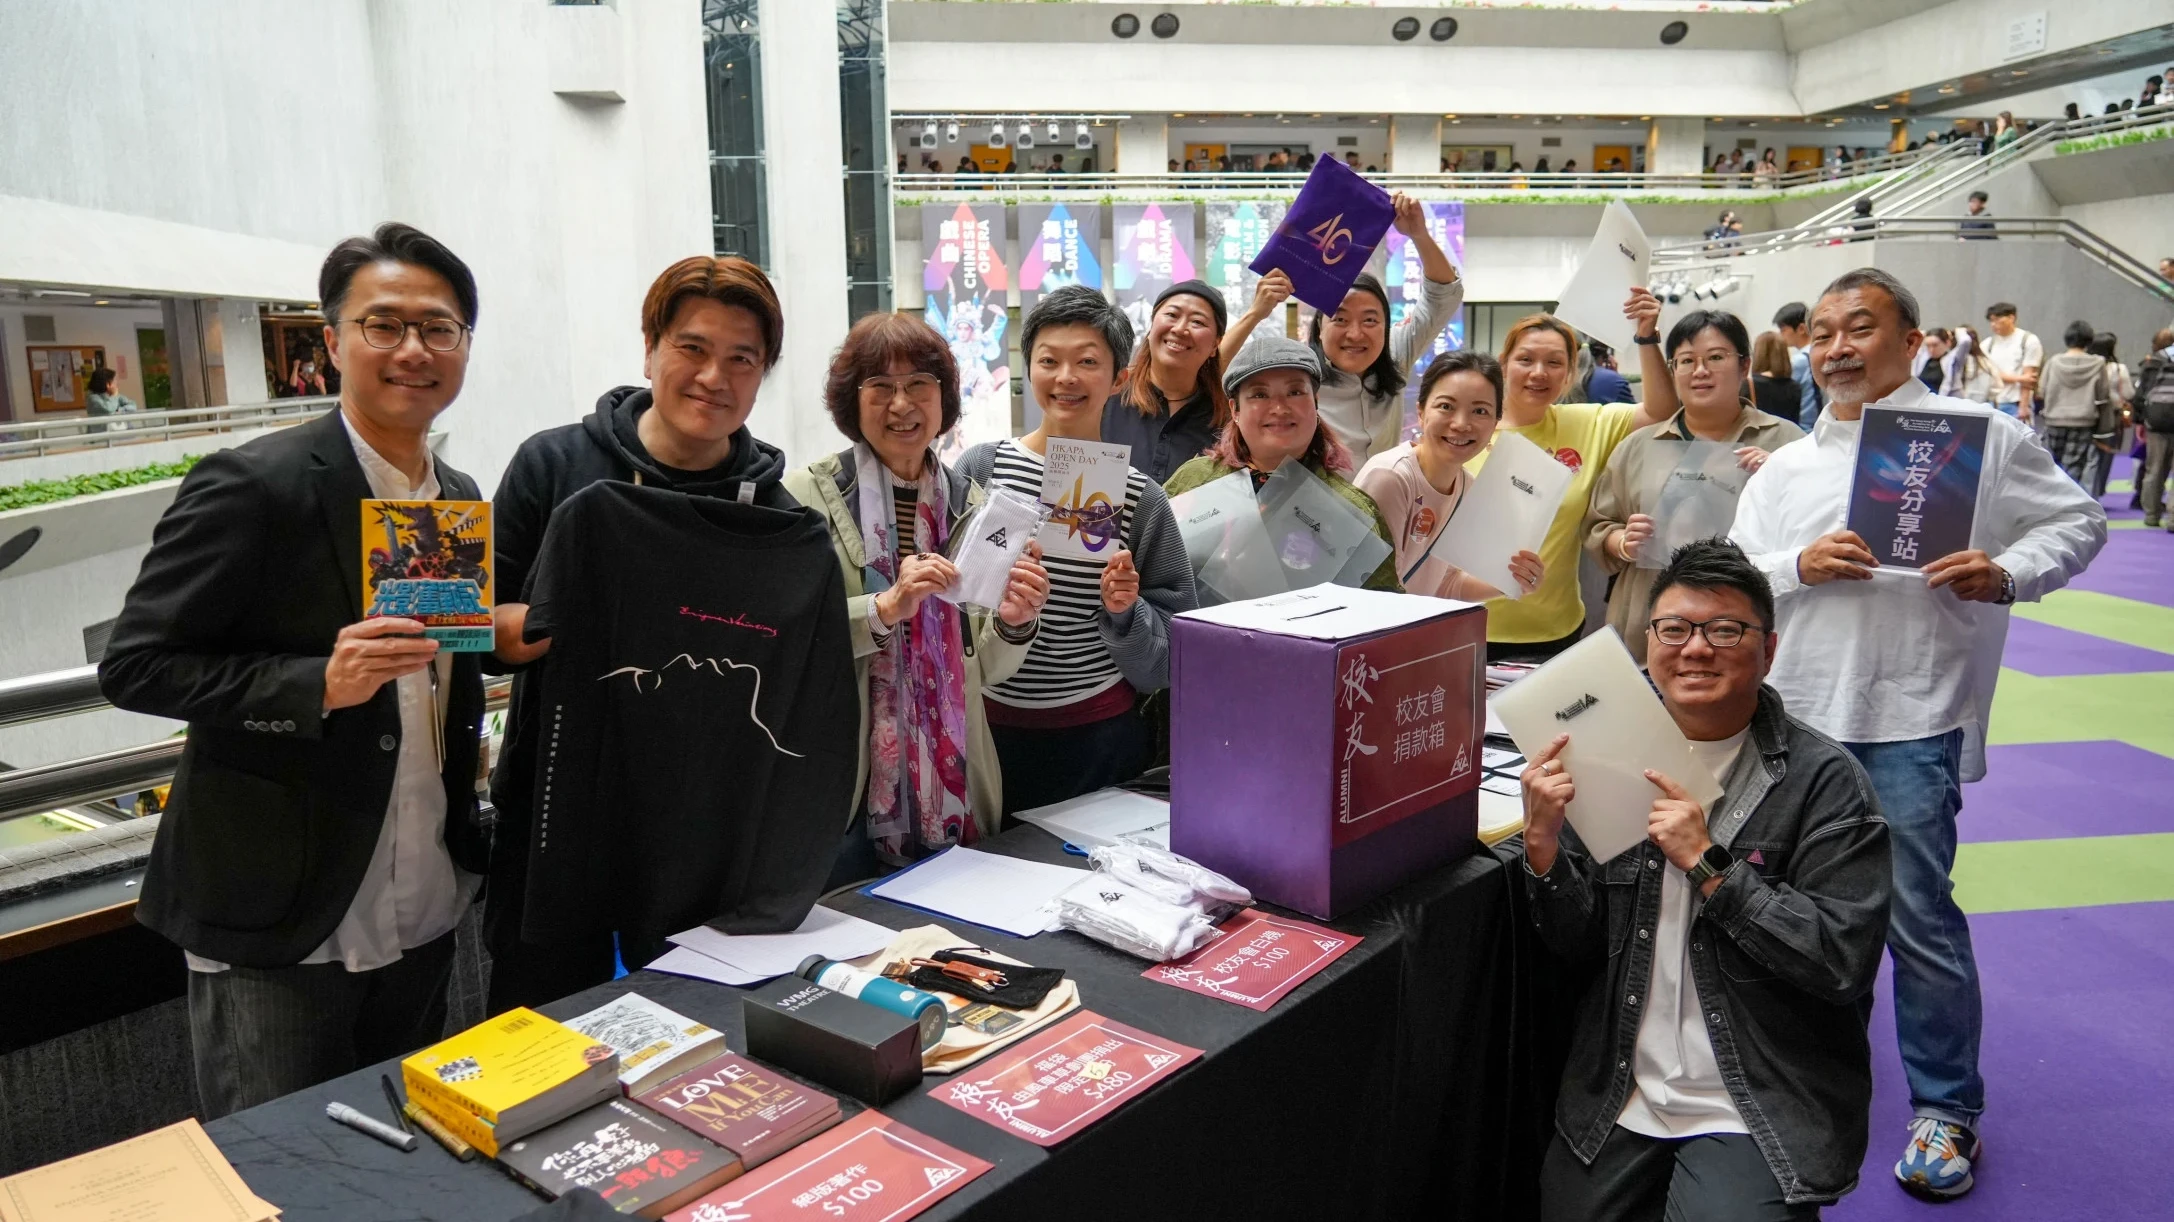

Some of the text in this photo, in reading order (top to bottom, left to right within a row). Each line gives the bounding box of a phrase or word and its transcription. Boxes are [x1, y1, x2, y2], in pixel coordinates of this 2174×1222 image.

[963, 220, 977, 289] CHINESE
[978, 219, 991, 273] OPERA
[1064, 219, 1078, 271] DANCE
[1159, 219, 1172, 273] DRAMA
[1049, 462, 1070, 470] 2025
[1050, 453, 1076, 463] OPEN
[1079, 455, 1099, 465] DAY
[1052, 444, 1085, 455] HKAPA
[1891, 440, 1935, 561] 校友分享站
[1396, 684, 1446, 727] 校友會
[1393, 720, 1446, 765] 捐款箱
[1339, 768, 1348, 824] ALUMNI
[1252, 947, 1291, 969] $100
[776, 985, 820, 1007] WMG
[787, 990, 832, 1012] THEATRE
[1034, 1052, 1070, 1073] 福袋
[658, 1064, 750, 1109] LOVE
[1083, 1070, 1133, 1101] $480
[707, 1119, 729, 1132] If
[1009, 1116, 1052, 1138] ALUMNI
[822, 1179, 884, 1216] $100
